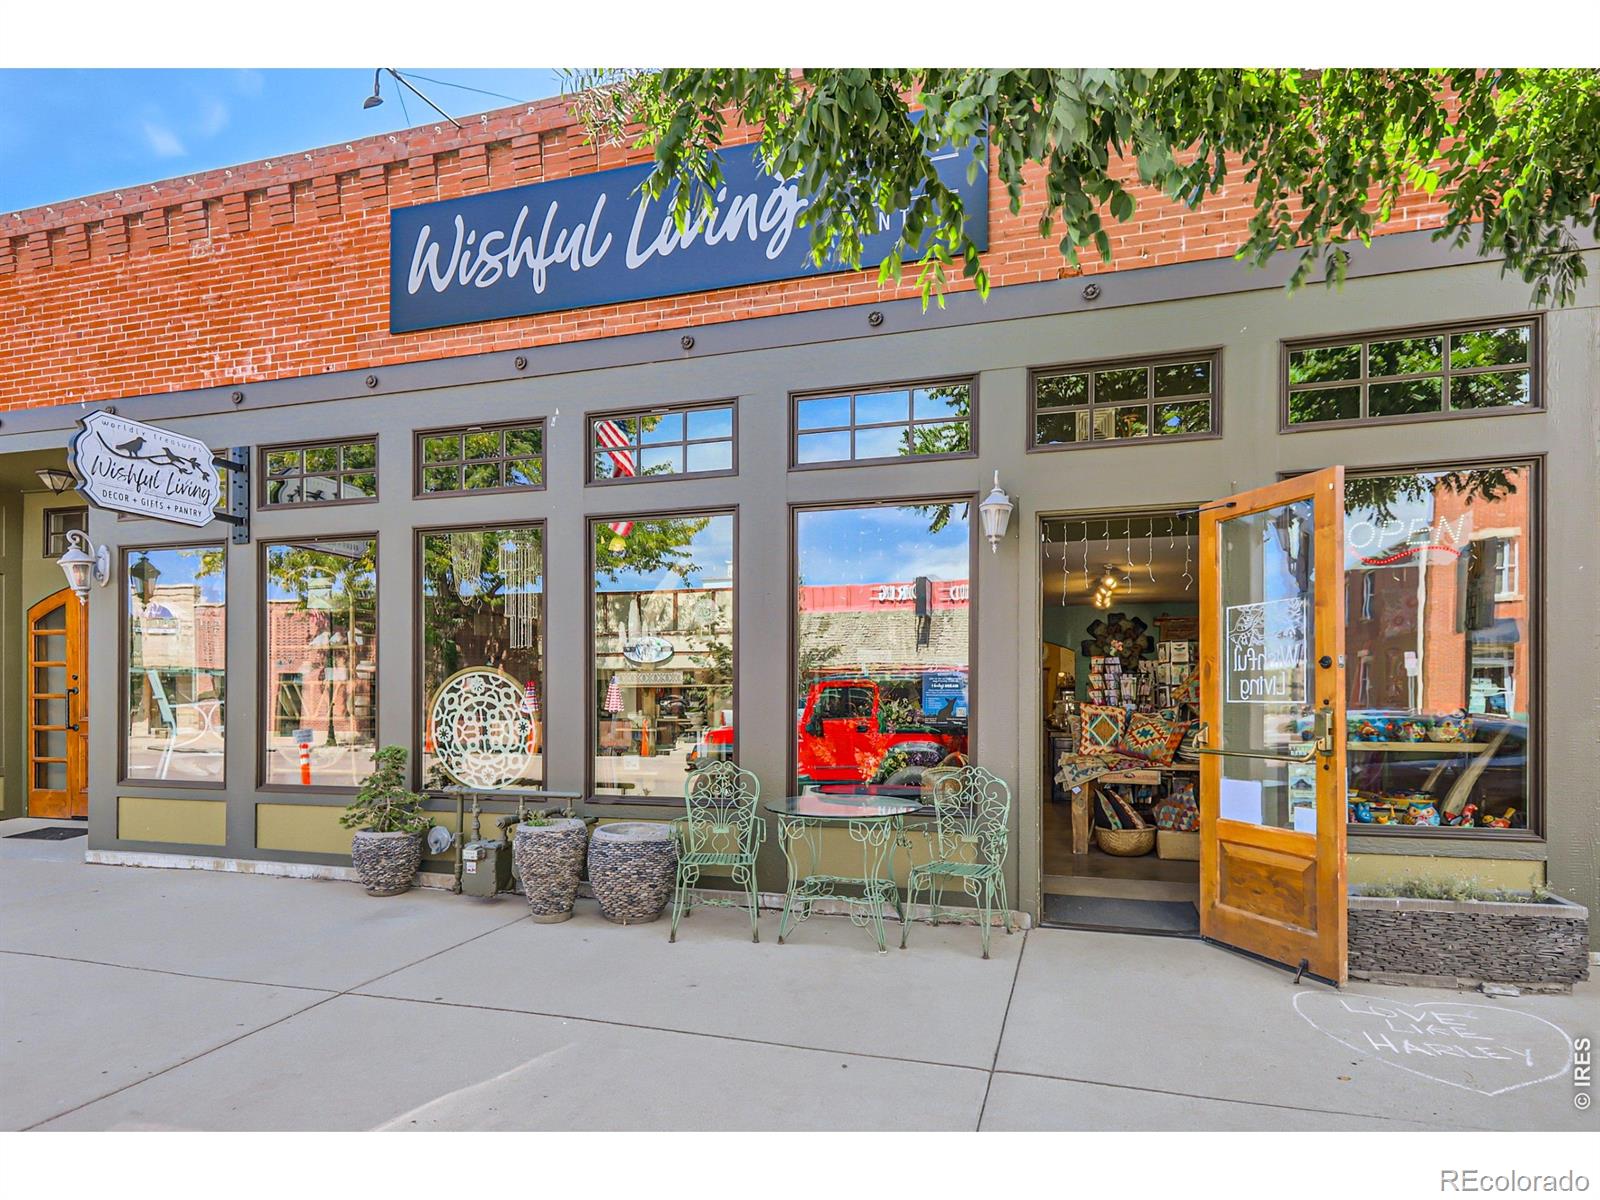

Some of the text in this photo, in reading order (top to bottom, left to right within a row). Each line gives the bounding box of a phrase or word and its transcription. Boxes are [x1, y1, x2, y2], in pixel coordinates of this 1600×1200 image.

[408, 183, 809, 295] Wishful Living
[101, 420, 203, 453] worldly treasures
[92, 455, 211, 505] Wishful Living
[103, 490, 129, 502] DECOR
[141, 497, 164, 510] GIFTS
[174, 505, 202, 517] PANTRY
[1347, 515, 1466, 549] OPEN
[1340, 999, 1479, 1025] LOVE
[1386, 1019, 1495, 1041] LIKE
[1363, 1031, 1535, 1067] HARLEY
